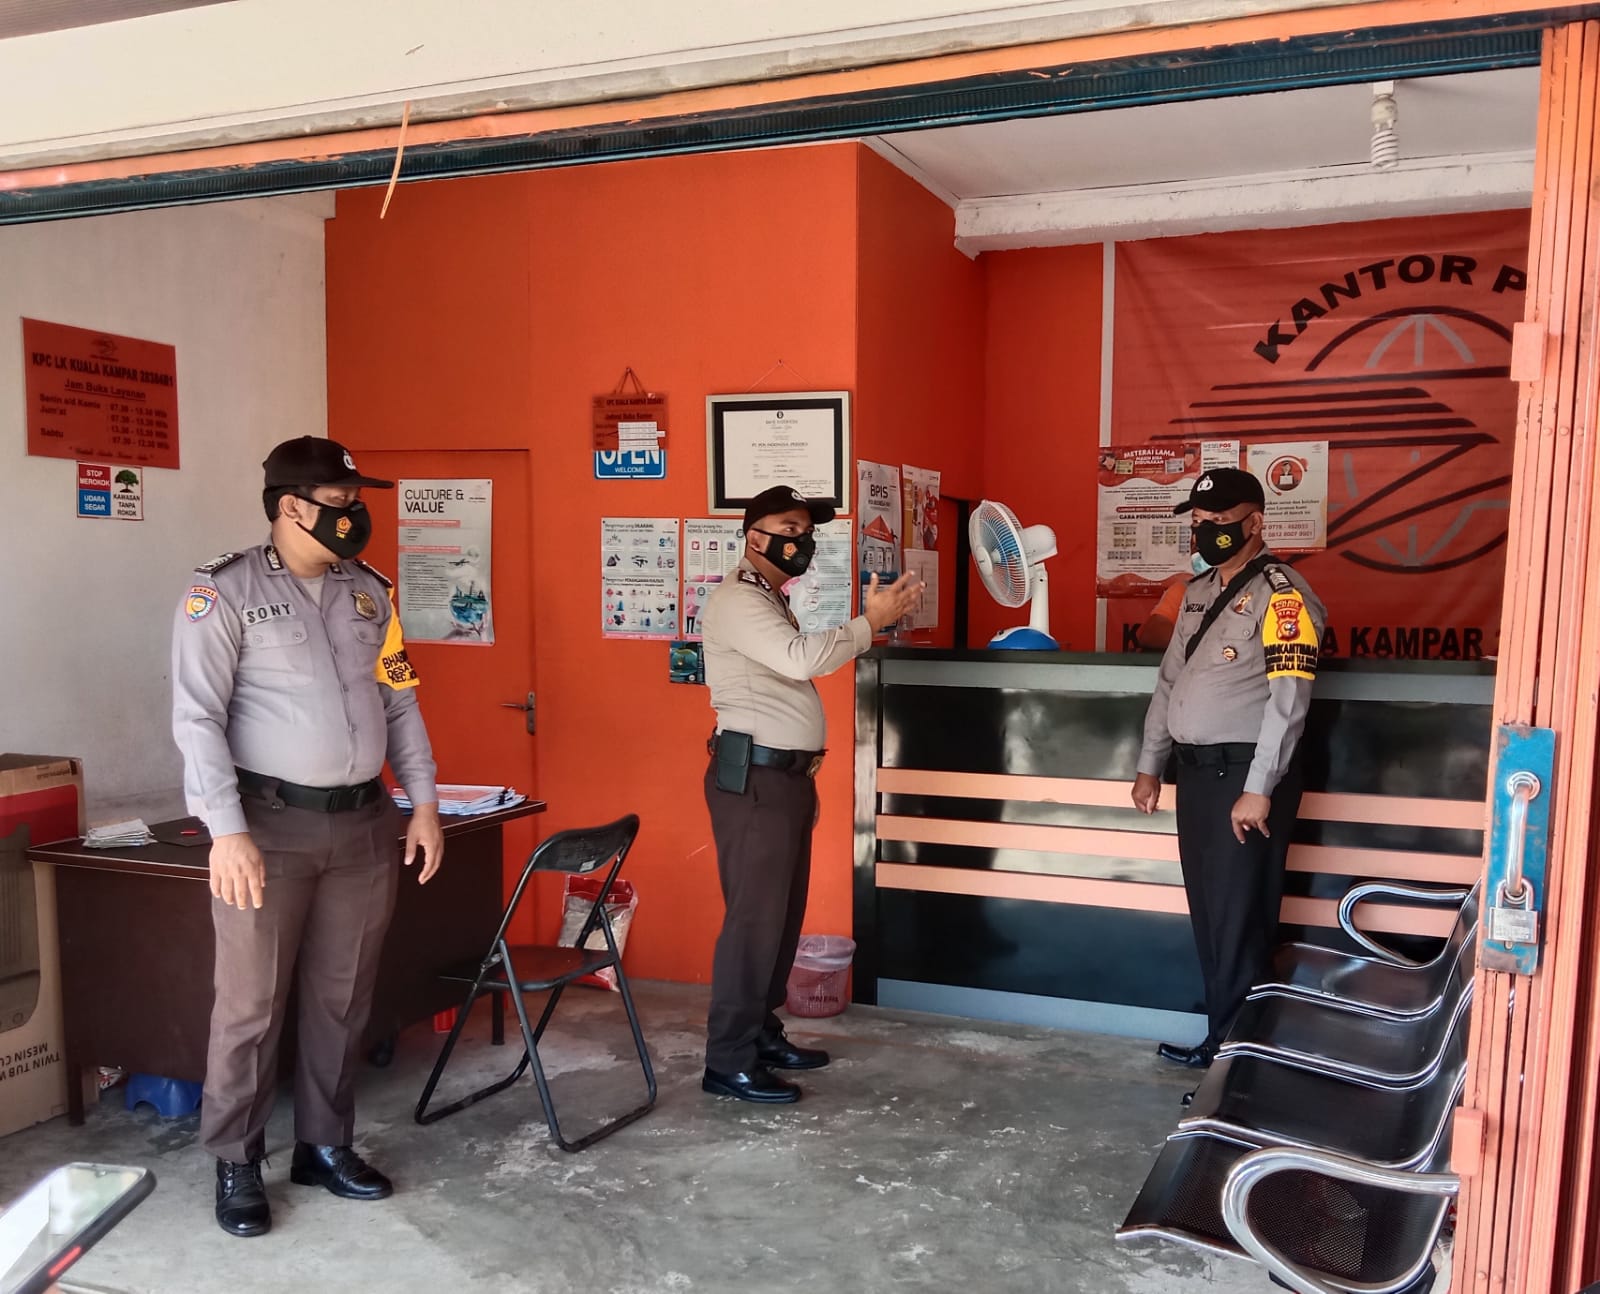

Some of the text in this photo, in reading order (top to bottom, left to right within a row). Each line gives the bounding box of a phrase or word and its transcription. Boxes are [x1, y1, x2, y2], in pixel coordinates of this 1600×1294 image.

[1253, 254, 1477, 364] KANTOR
[32, 352, 52, 368] KPC
[54, 356, 67, 371] LK
[70, 358, 100, 375] KUALA
[102, 364, 138, 381] KAMPAR
[64, 378, 146, 399] Jam Buka Layanan
[1155, 449, 1175, 457] LAMA
[86, 469, 103, 477] STOP
[80, 477, 110, 487] MEROKOK
[113, 493, 140, 502] KAWASAN
[404, 489, 453, 500] CULTURE
[455, 489, 464, 500] &
[870, 484, 888, 499] BPIS
[84, 495, 106, 503] UDARA
[118, 501, 136, 509] TANPA
[84, 503, 106, 511] SEGAR
[117, 509, 137, 517] ROKOK
[404, 501, 444, 513] VALUE
[246, 602, 291, 624] SONY
[1350, 626, 1484, 660] KAMPAR
[14, 1042, 48, 1062] MESIN
[33, 1051, 60, 1069] TWIN
[9, 1062, 31, 1078] TUB
